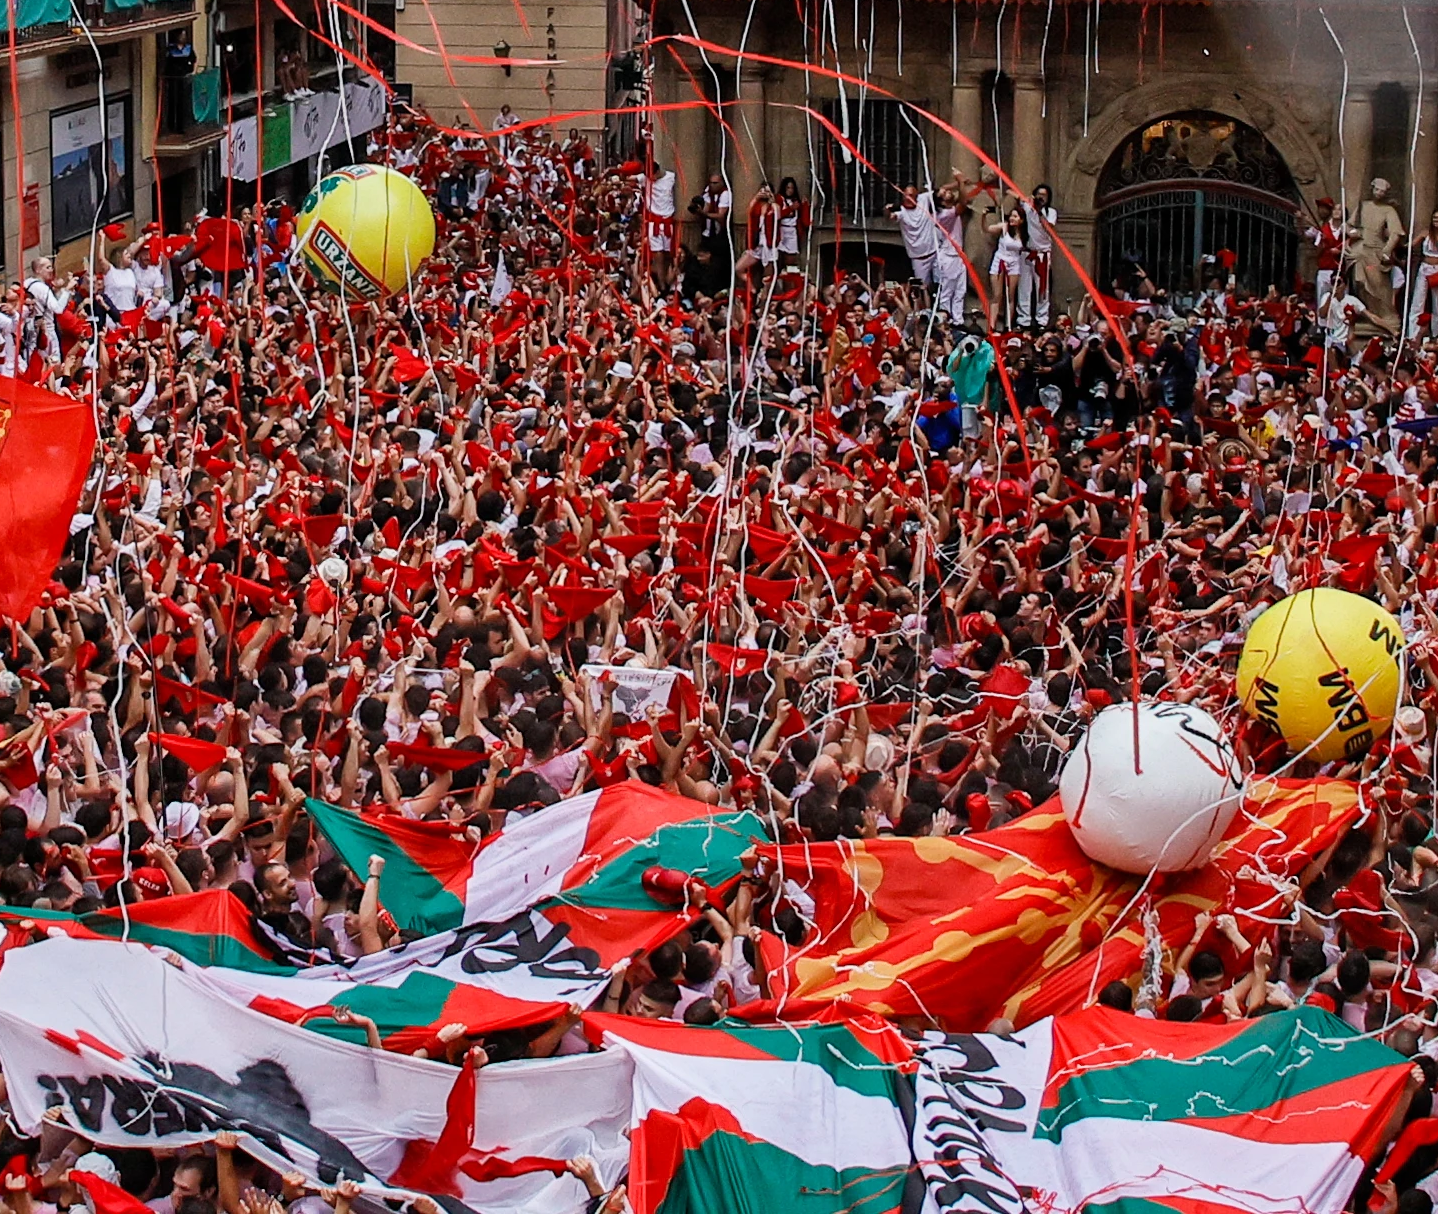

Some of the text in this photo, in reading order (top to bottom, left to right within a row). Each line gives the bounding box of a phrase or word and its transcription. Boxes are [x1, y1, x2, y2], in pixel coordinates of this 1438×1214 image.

[546, 7, 557, 118] FARMACI
[316, 229, 380, 300] URZANTE
[138, 877, 160, 891] KELER
